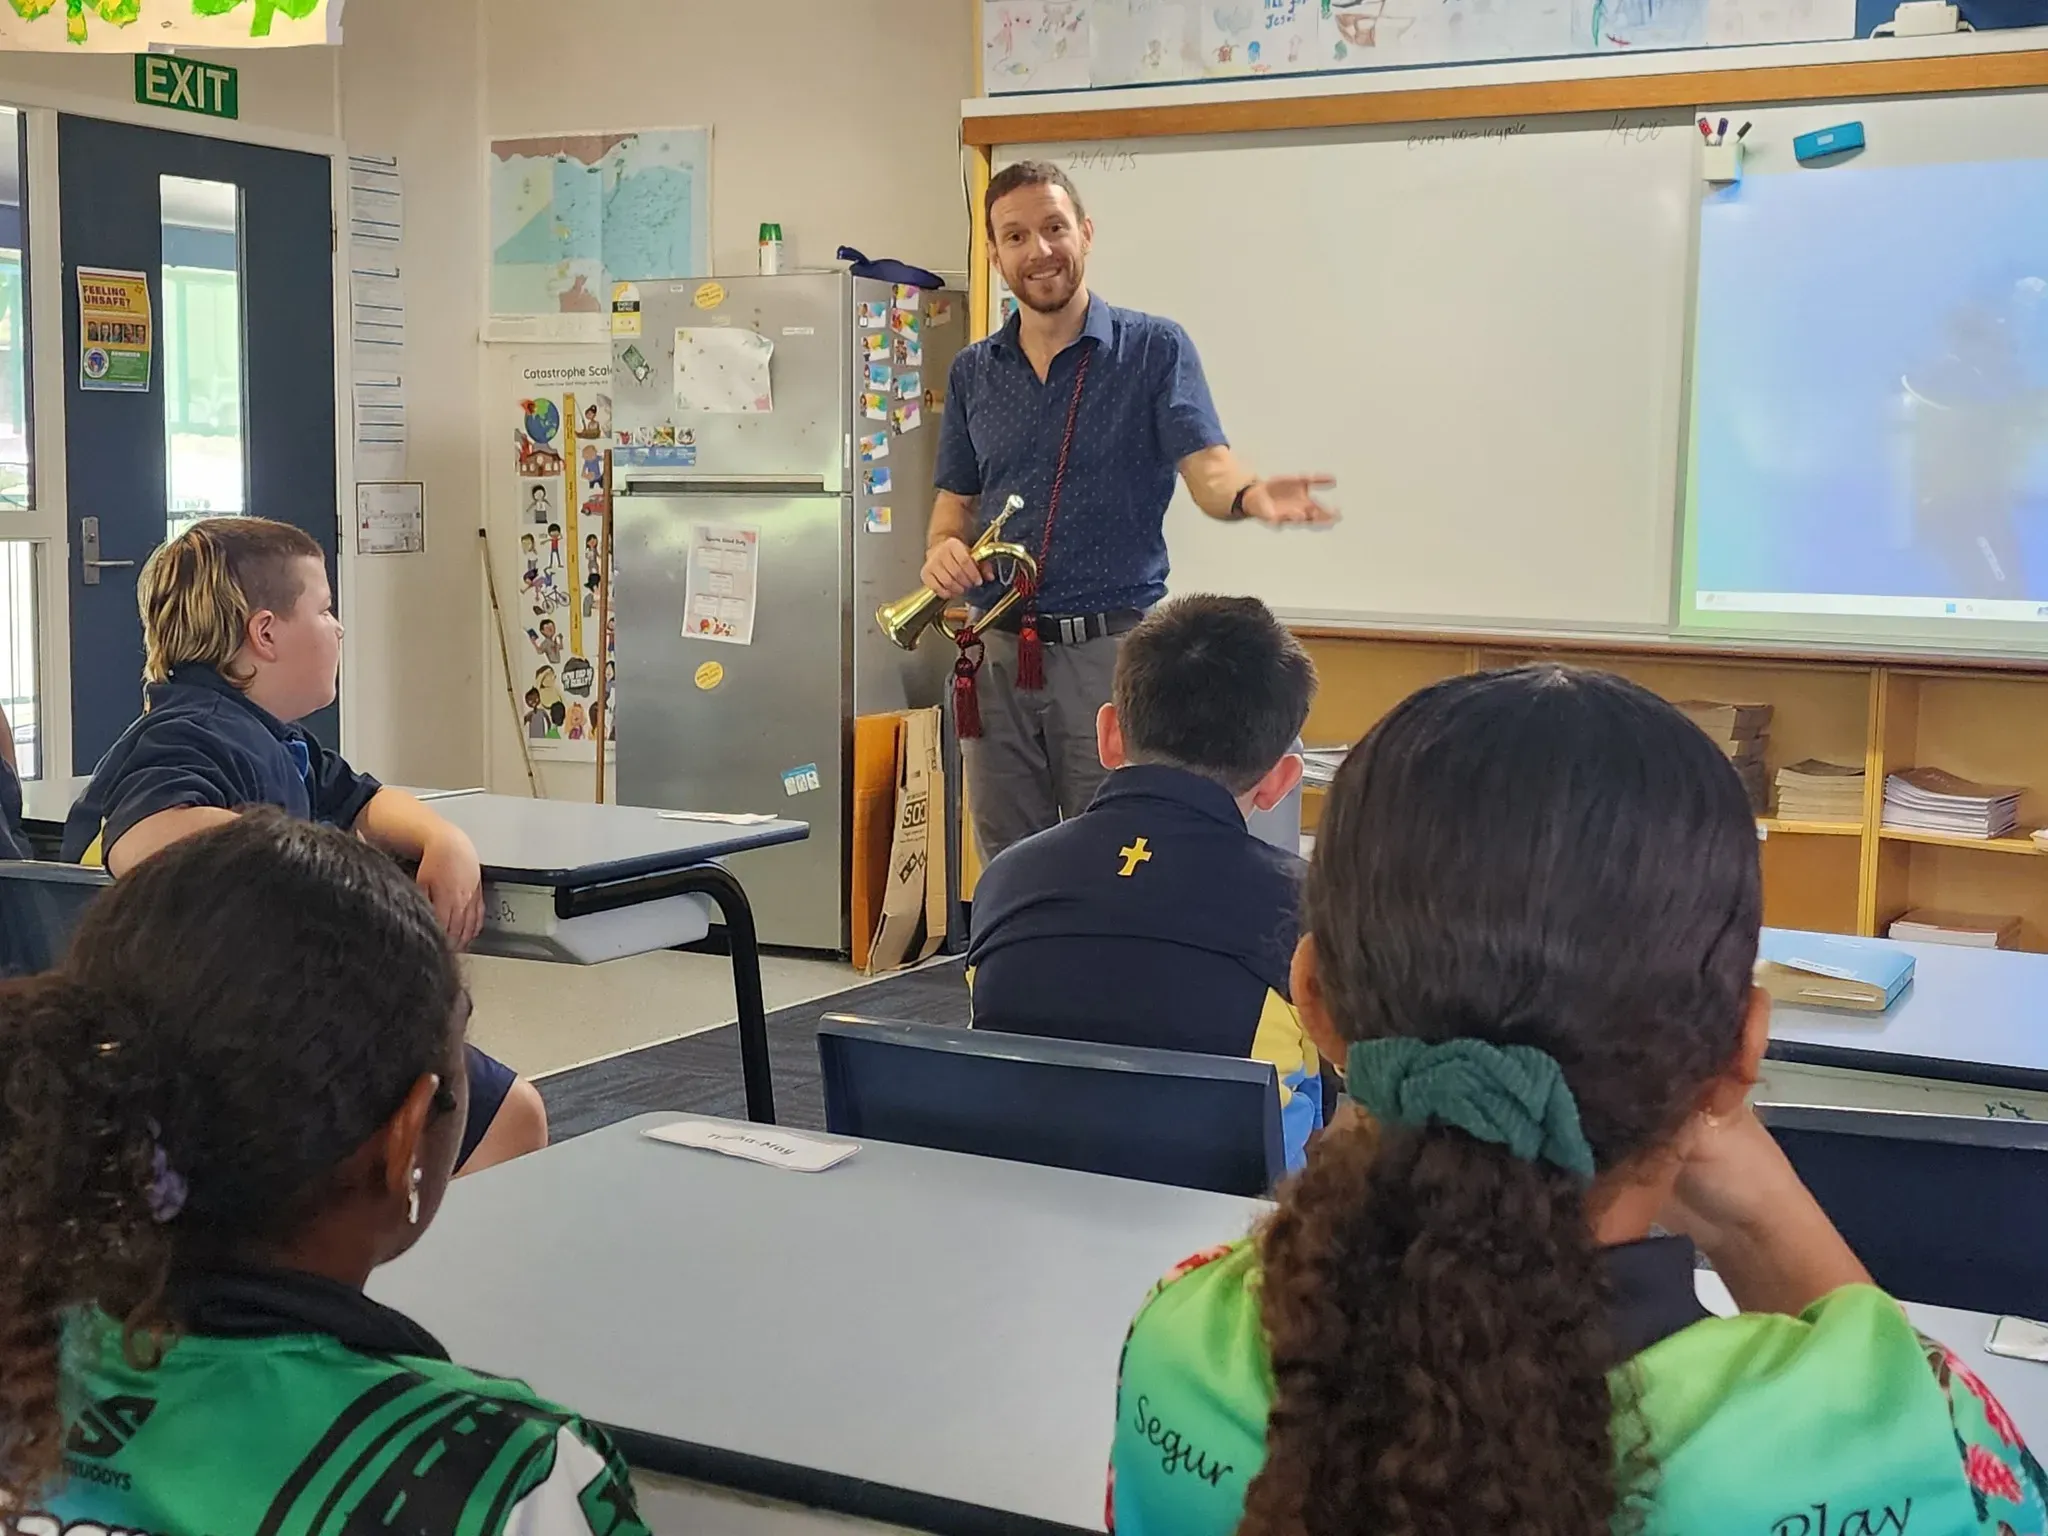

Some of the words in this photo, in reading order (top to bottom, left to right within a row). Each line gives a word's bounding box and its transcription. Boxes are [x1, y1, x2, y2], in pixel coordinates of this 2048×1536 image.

[145, 56, 230, 112] EXIT
[83, 285, 126, 297] FEELING
[84, 295, 131, 308] UNSAFE?
[523, 366, 586, 380] Catastrophe
[588, 365, 613, 377] Scal
[1134, 1394, 1234, 1488] Segur
[1770, 1497, 1912, 1536] Play
